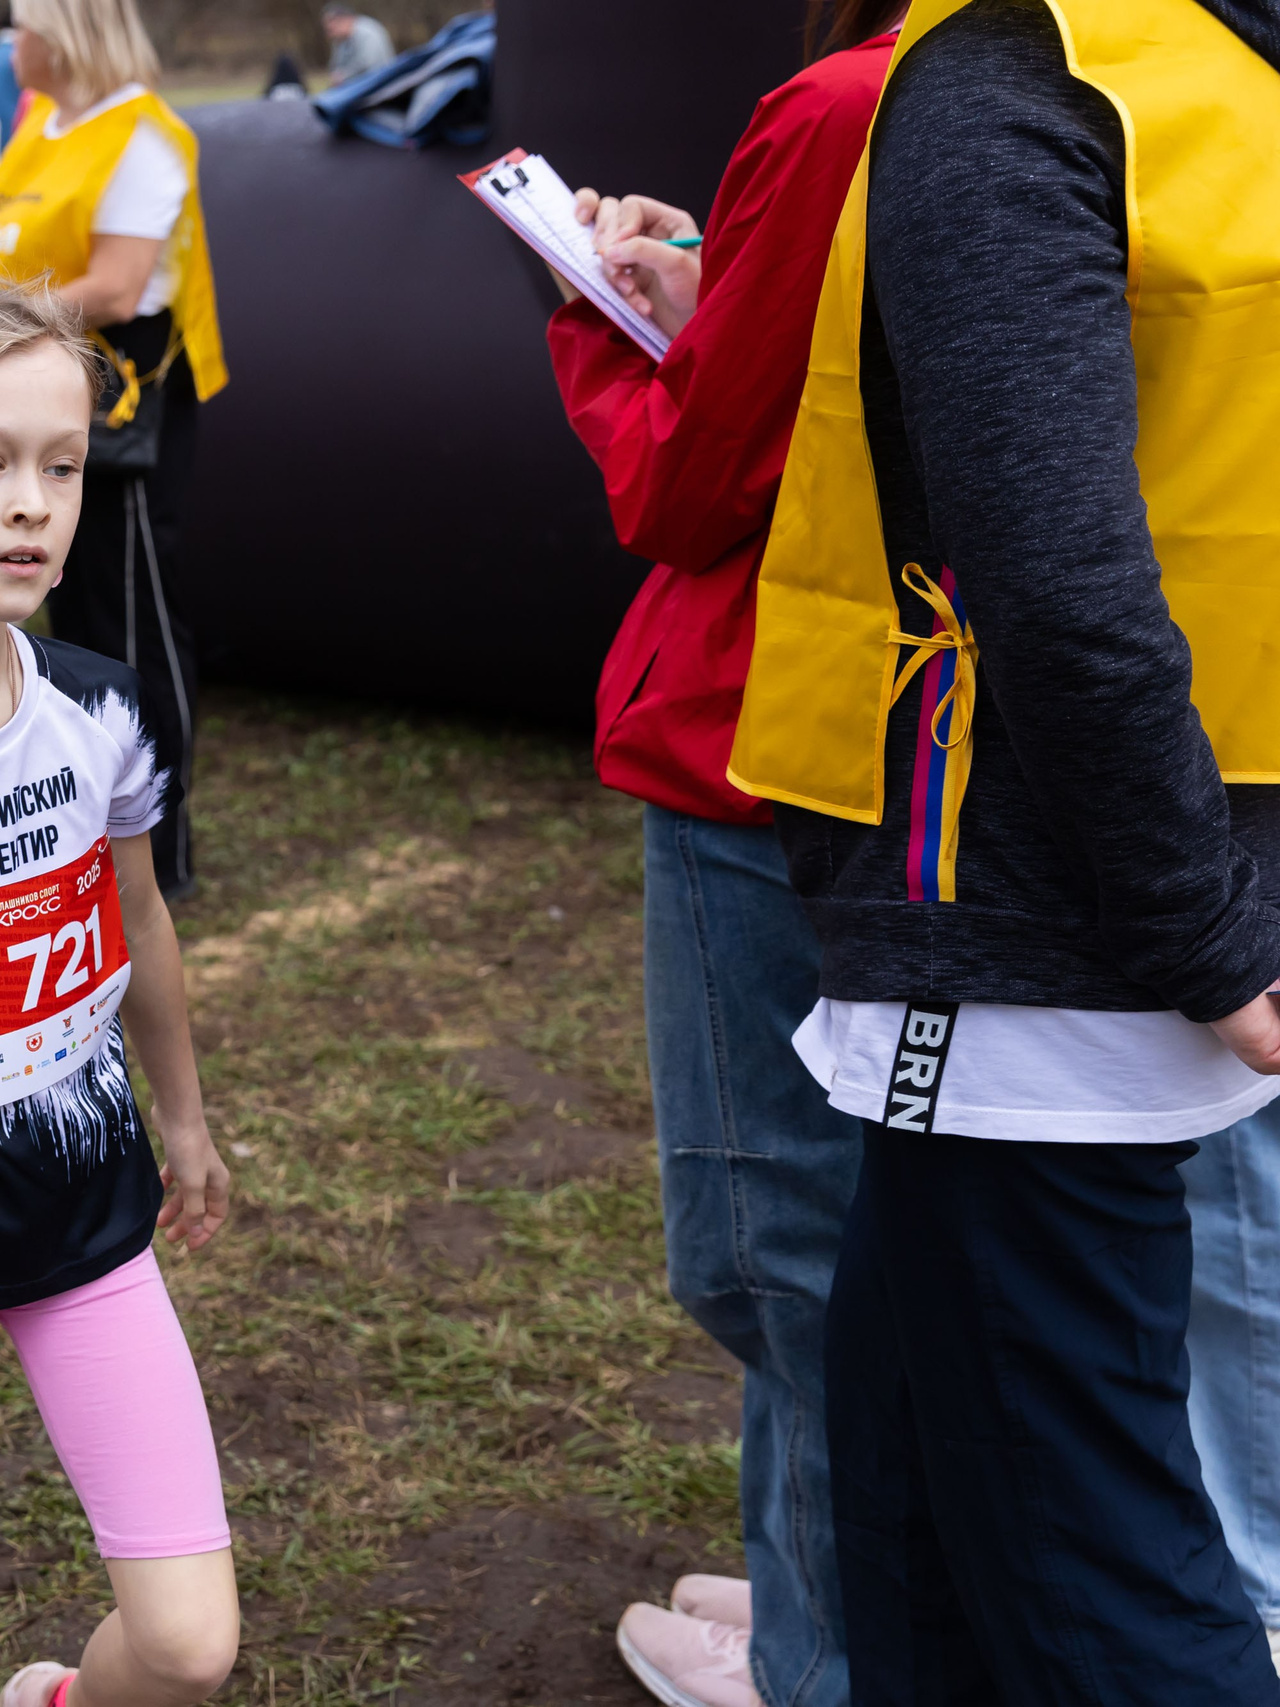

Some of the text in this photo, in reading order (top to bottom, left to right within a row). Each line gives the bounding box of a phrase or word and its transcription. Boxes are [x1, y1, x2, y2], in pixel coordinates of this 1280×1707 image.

[39, 884, 60, 899] СПОРТ
[76, 857, 101, 896] 2025
[7, 903, 103, 1013] 721
[887, 1009, 950, 1134] BRN
